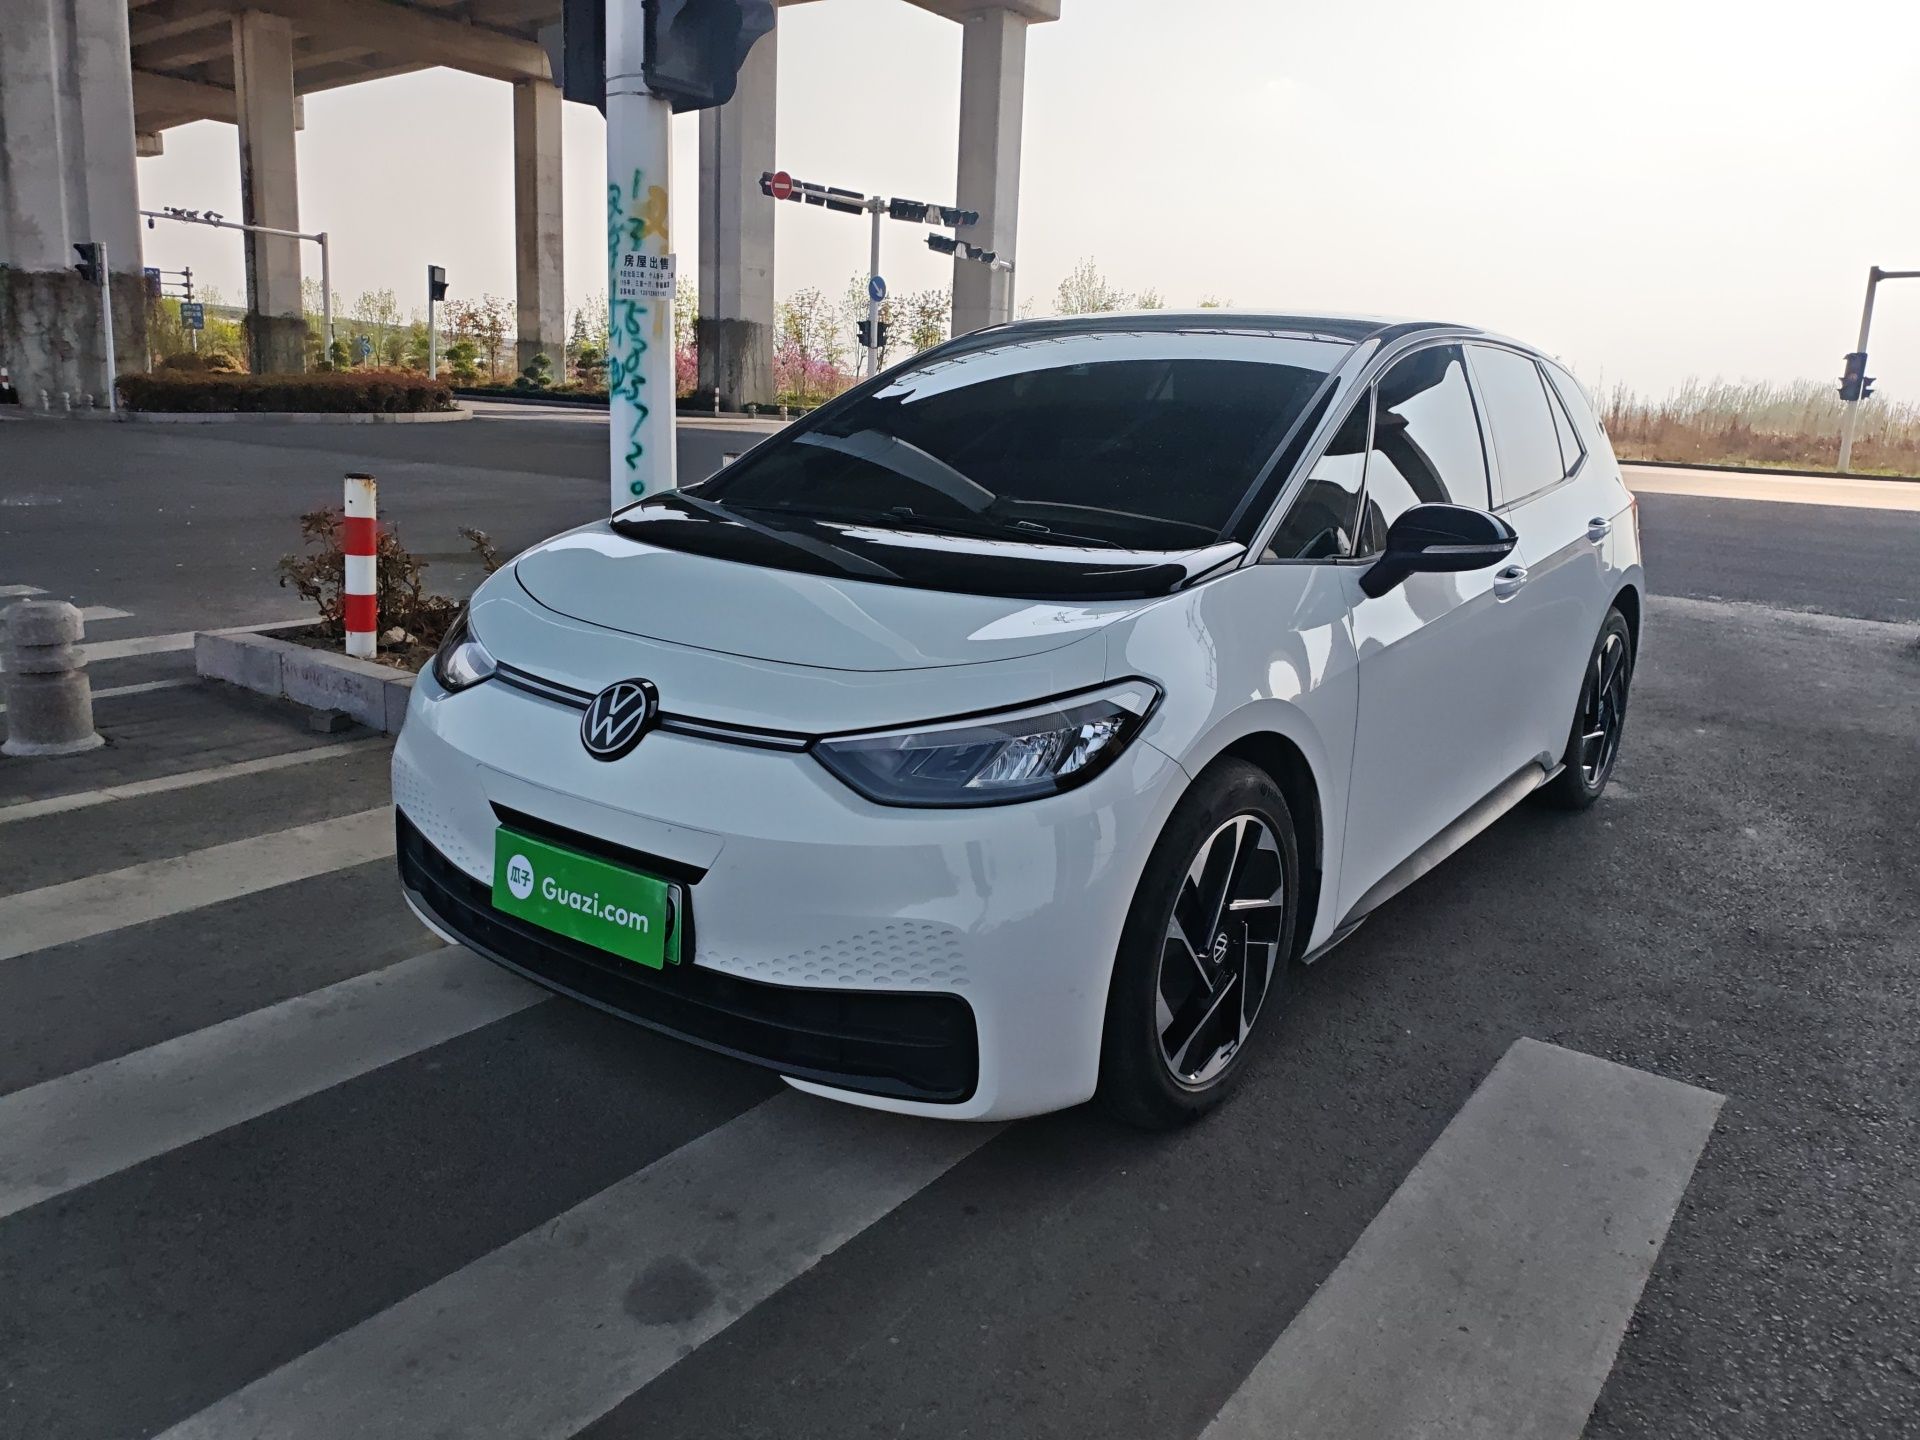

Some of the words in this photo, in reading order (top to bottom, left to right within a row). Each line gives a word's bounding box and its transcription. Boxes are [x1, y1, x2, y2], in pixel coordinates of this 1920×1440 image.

[624, 254, 669, 270] 房屋出售
[582, 683, 646, 753] VW
[510, 865, 531, 887] 瓜子
[542, 876, 649, 934] Guazi.com
